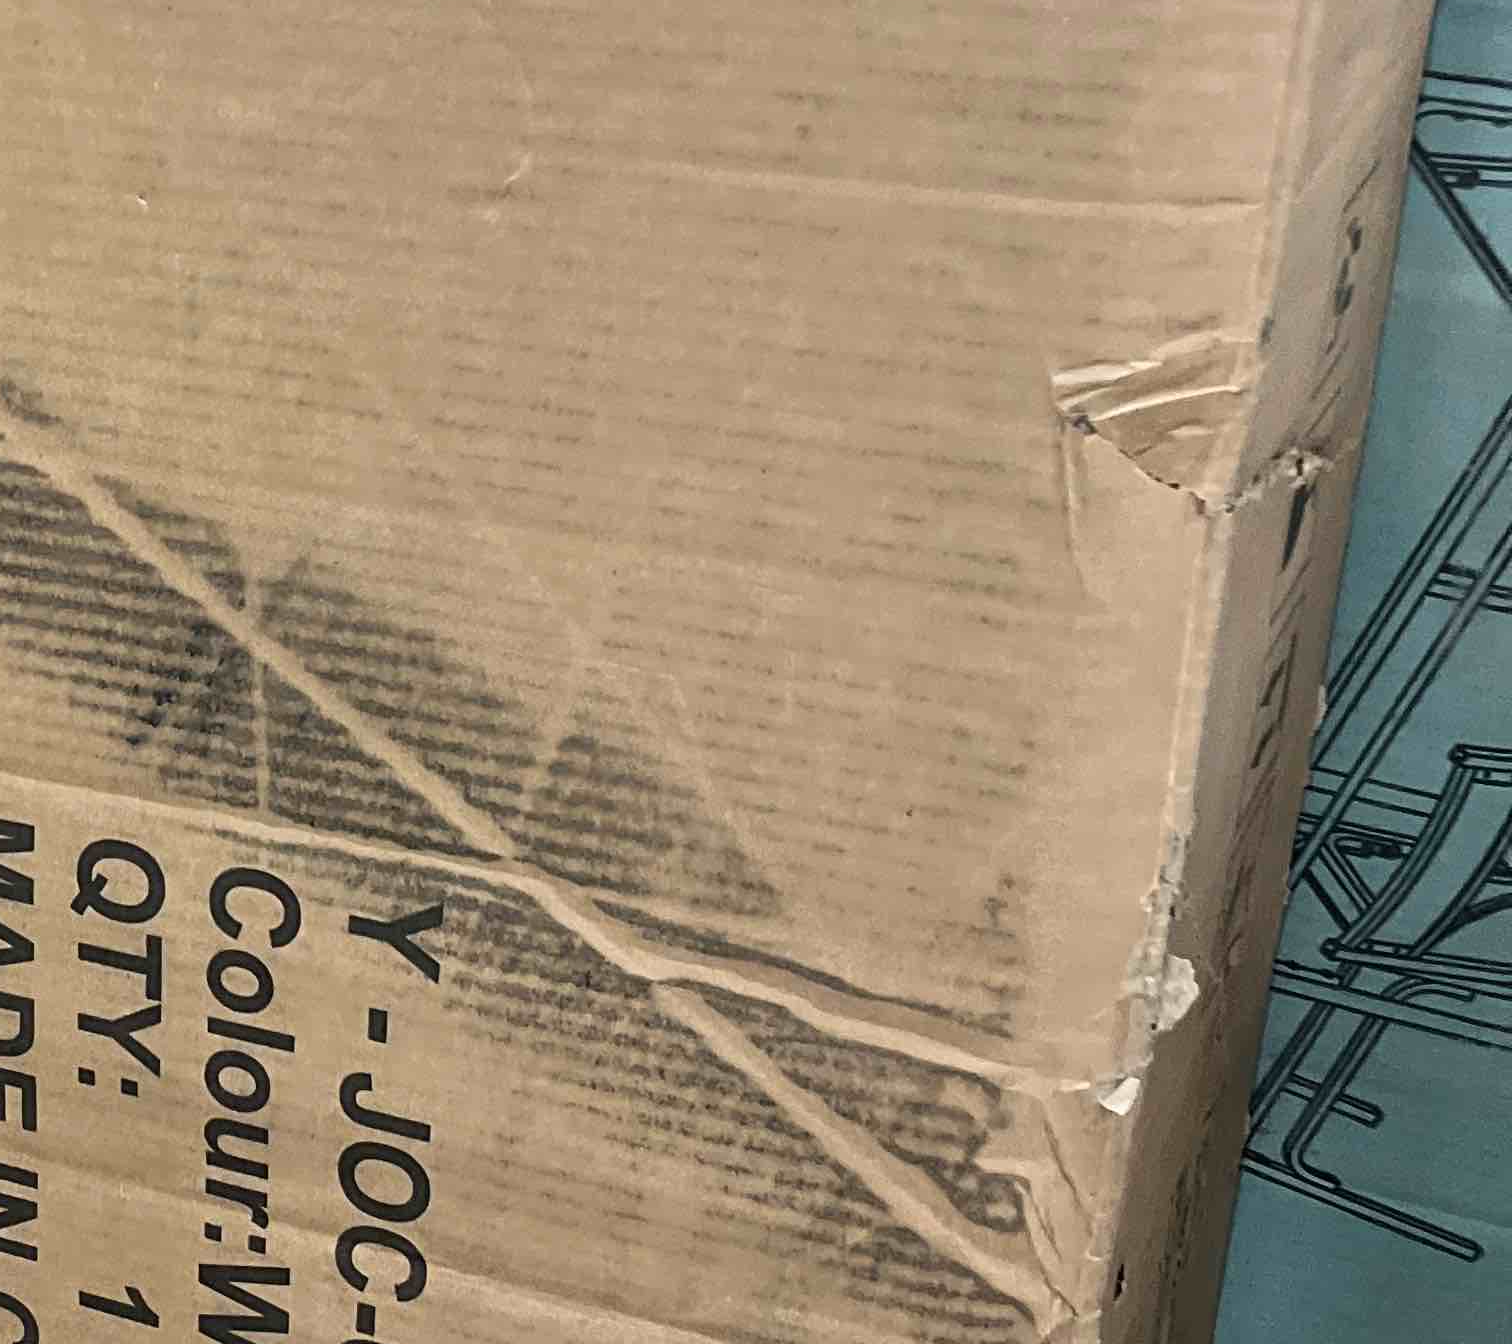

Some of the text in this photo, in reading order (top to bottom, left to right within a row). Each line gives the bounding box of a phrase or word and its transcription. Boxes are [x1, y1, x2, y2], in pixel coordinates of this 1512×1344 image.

[69, 838, 166, 1329] QTY: 1
[348, 903, 445, 983] Y
